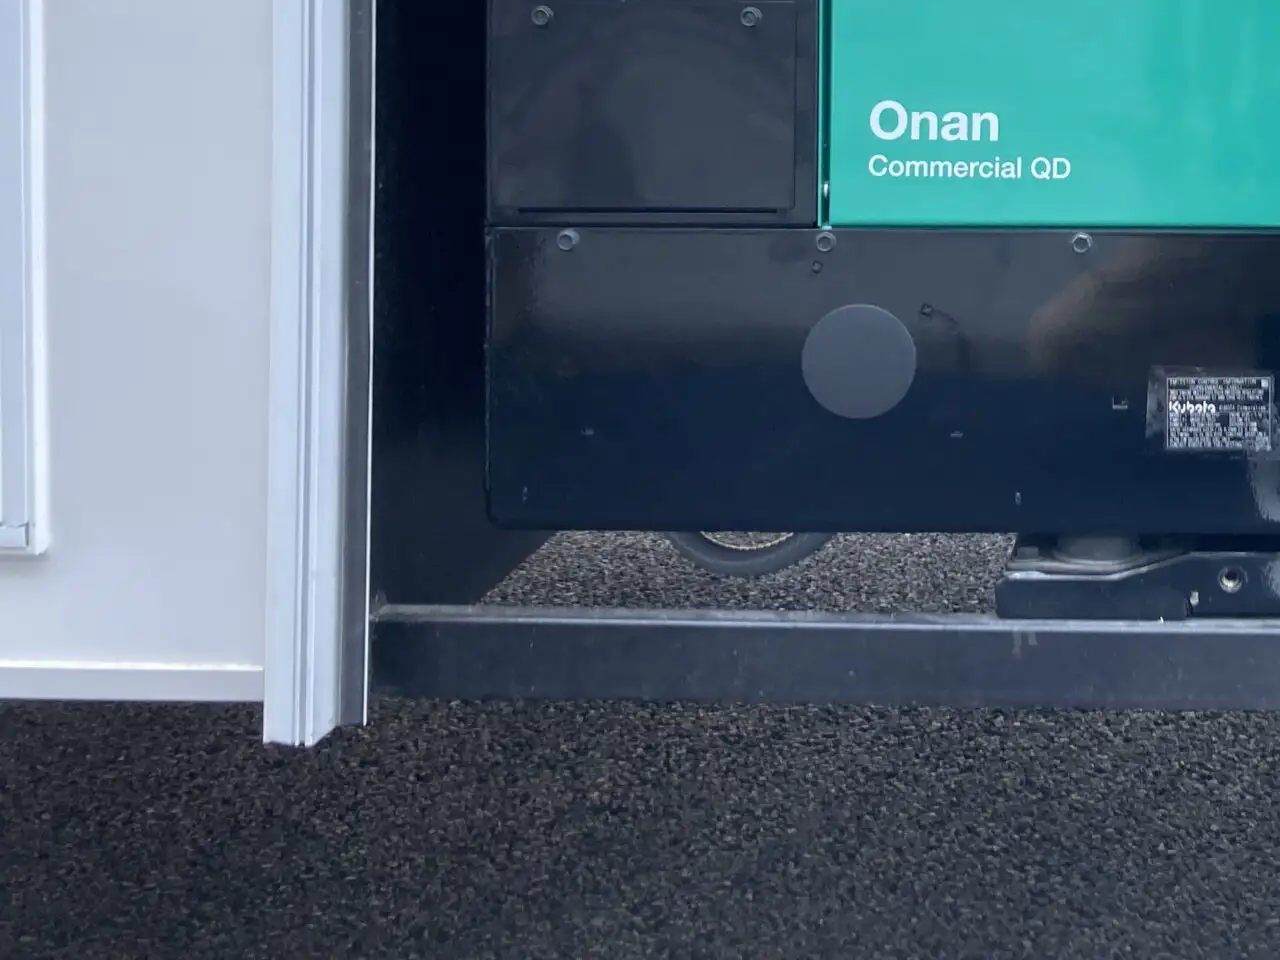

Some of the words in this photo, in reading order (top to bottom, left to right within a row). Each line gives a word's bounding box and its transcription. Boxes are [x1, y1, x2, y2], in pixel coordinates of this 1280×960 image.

[869, 99, 999, 141] Onan
[868, 154, 1022, 179] Commercial
[1030, 156, 1071, 180] QD
[1168, 400, 1216, 414] Kubota
